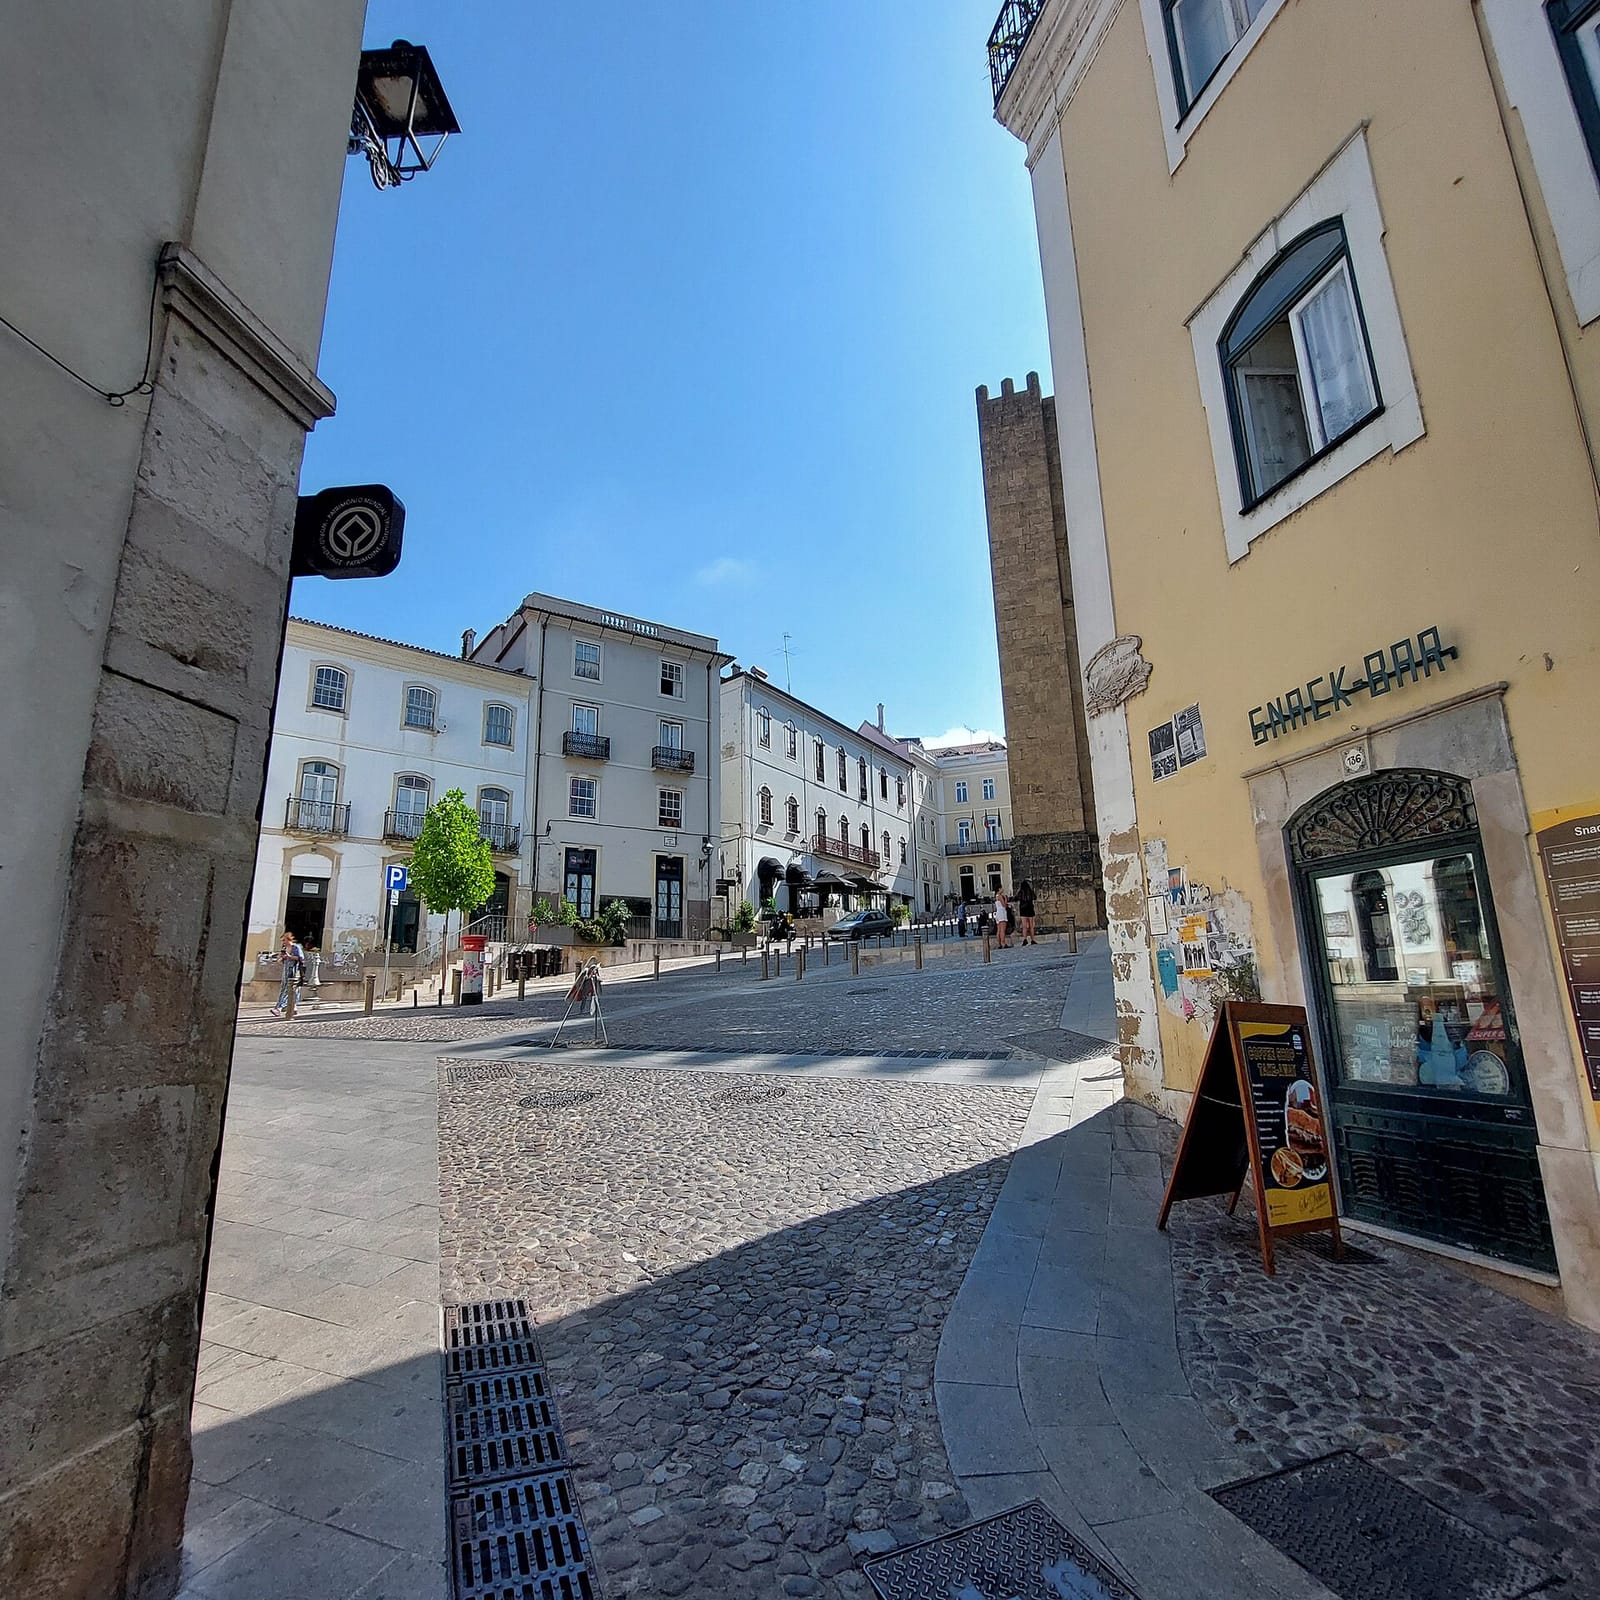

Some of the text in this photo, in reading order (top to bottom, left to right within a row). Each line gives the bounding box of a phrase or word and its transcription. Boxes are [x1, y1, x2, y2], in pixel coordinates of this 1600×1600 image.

[1247, 625, 1446, 746] SNACK-BAR
[1347, 754, 1362, 767] 136
[390, 868, 403, 888] P
